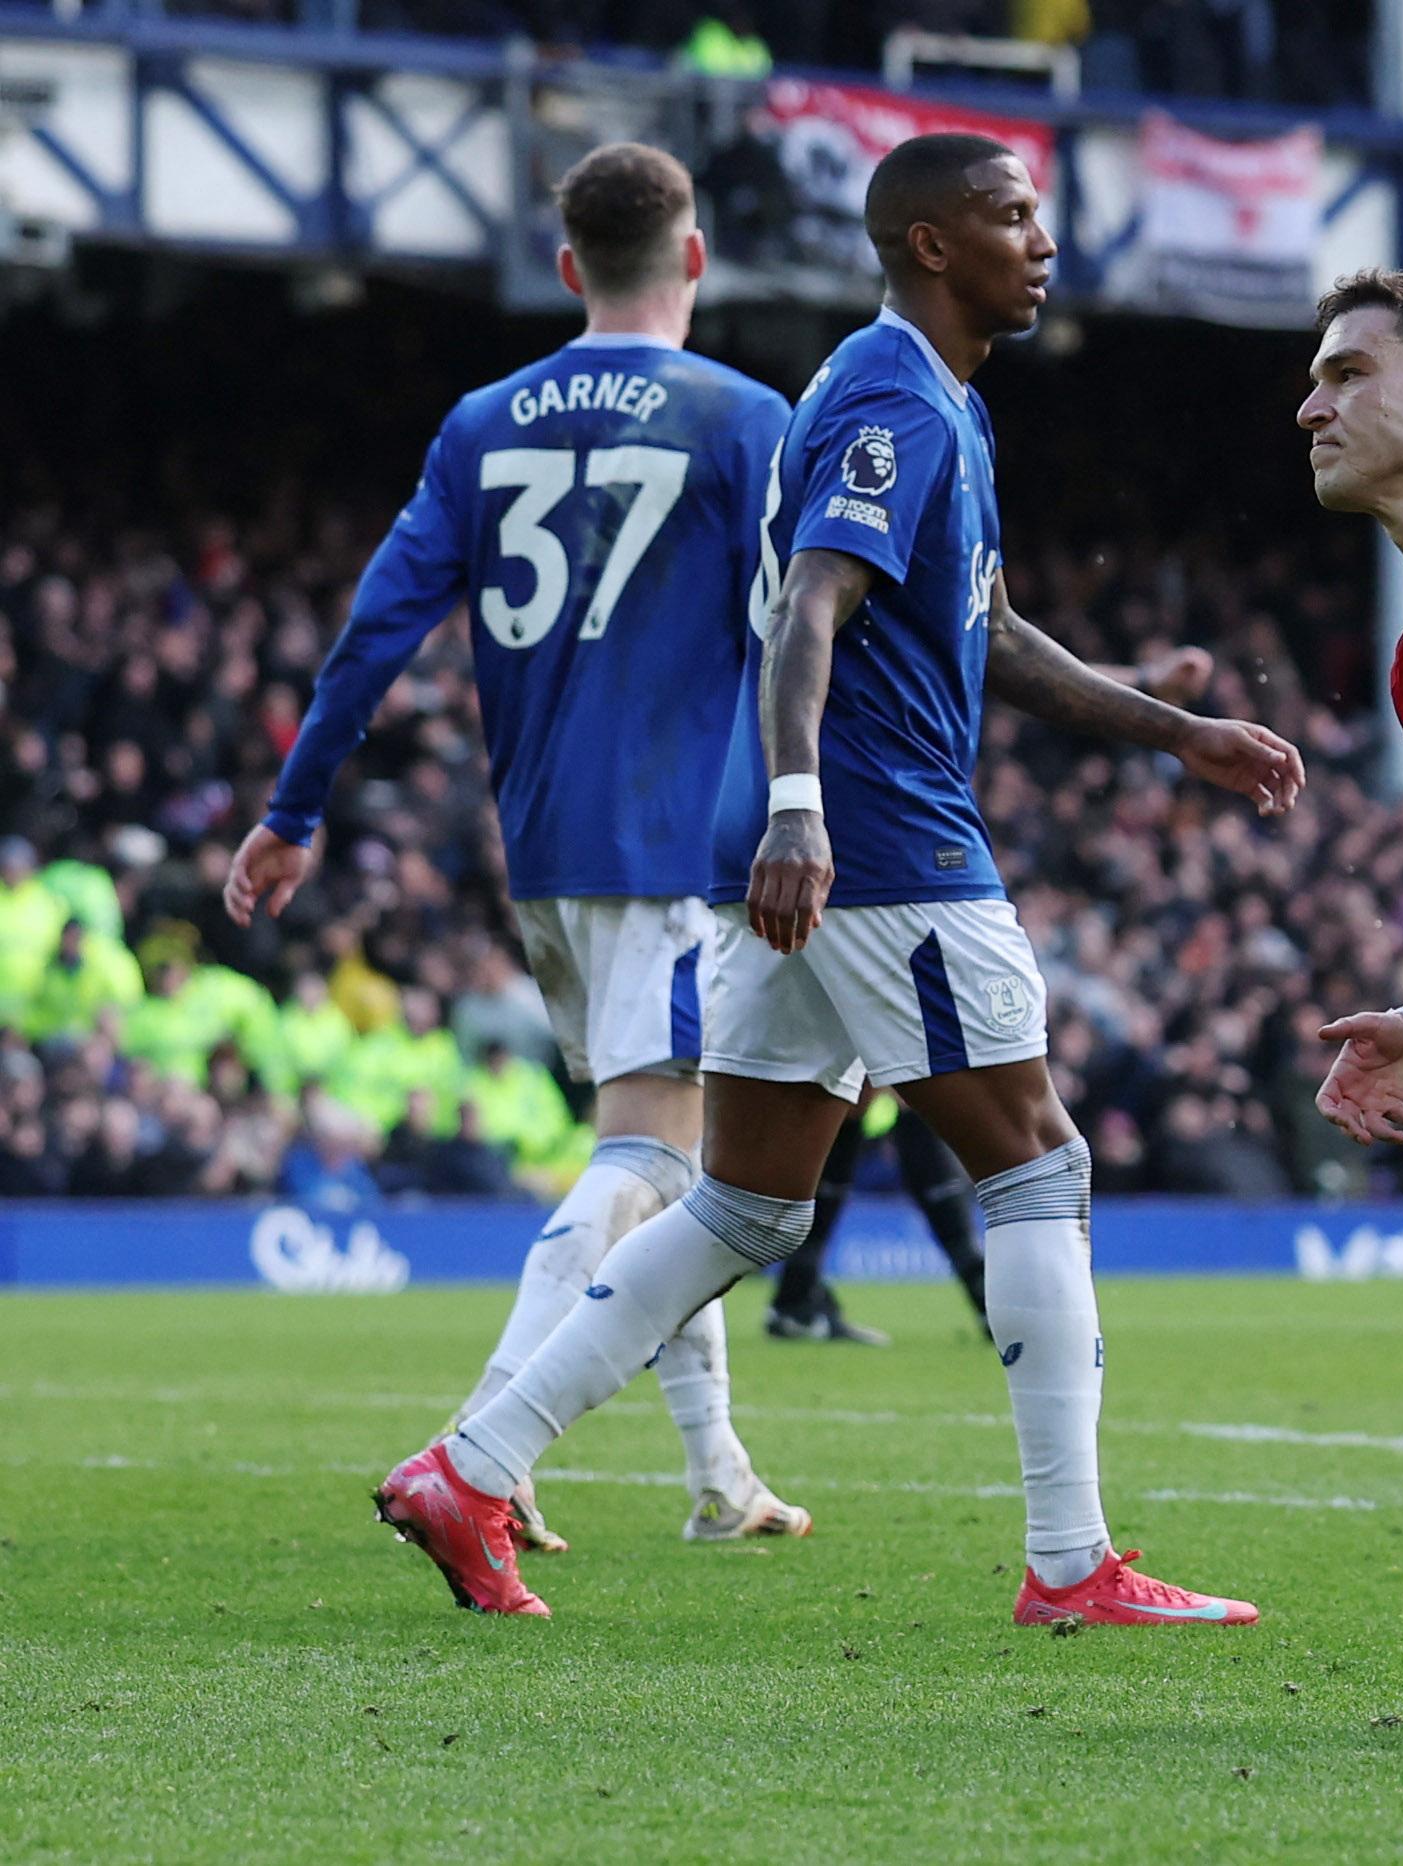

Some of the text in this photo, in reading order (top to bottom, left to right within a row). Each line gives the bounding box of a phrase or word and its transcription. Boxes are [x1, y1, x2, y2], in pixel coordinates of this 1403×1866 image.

[511, 372, 668, 426] GARNER
[828, 495, 888, 521] No room
[480, 445, 690, 650] 37
